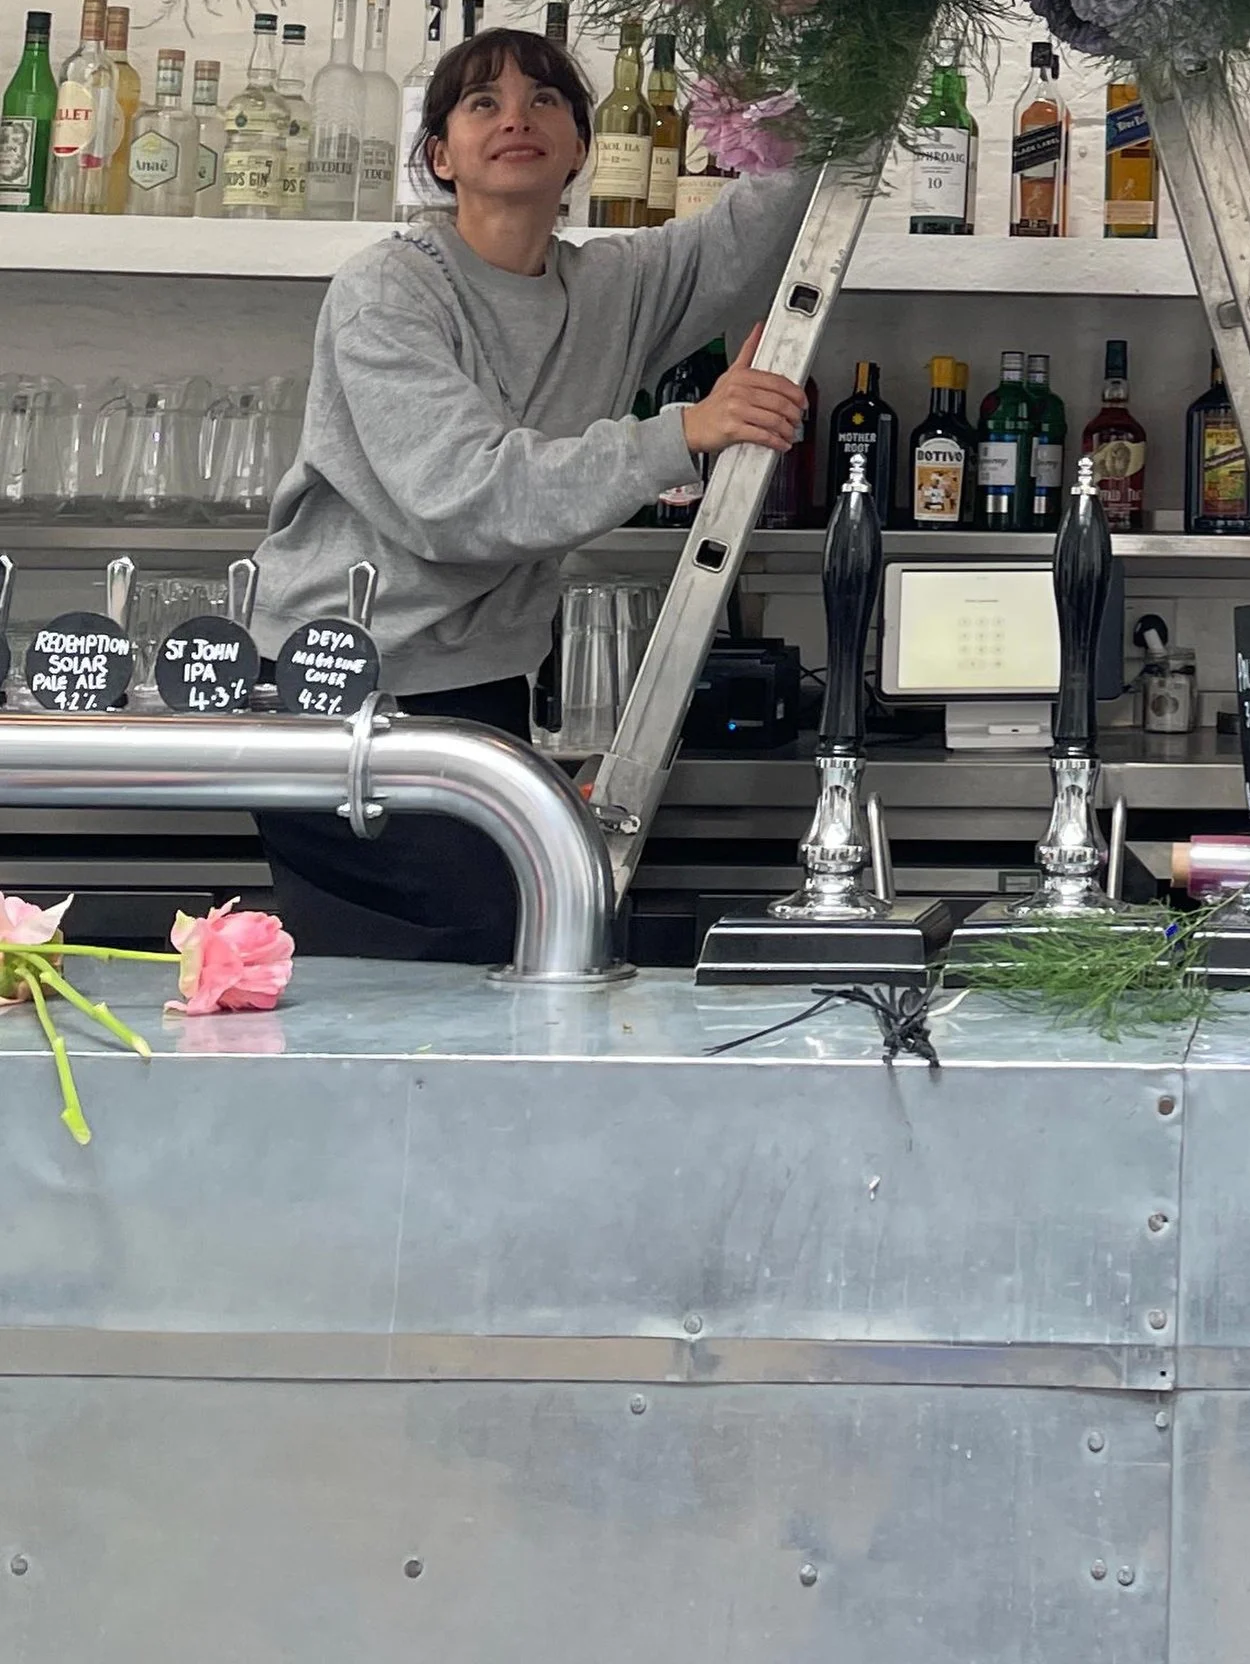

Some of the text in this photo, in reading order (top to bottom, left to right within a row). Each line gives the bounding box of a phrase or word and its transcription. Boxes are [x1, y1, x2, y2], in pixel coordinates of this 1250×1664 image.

[927, 177, 942, 189] 10
[838, 432, 877, 443] MOTHER
[844, 443, 870, 453] ROOT
[916, 449, 964, 463] BOTIVO
[34, 630, 130, 656] REDEMPTION
[306, 628, 355, 650] DEYA
[164, 638, 240, 662] ST JOHN
[48, 654, 109, 675] SOLAR
[183, 662, 217, 683] IPA
[290, 650, 367, 674] MAGAZINE
[32, 672, 107, 691] PALE ALE
[304, 668, 348, 689] COVER
[53, 692, 98, 712] 4.2%
[188, 679, 248, 711] 4.3%
[297, 688, 342, 715] 4.2%
